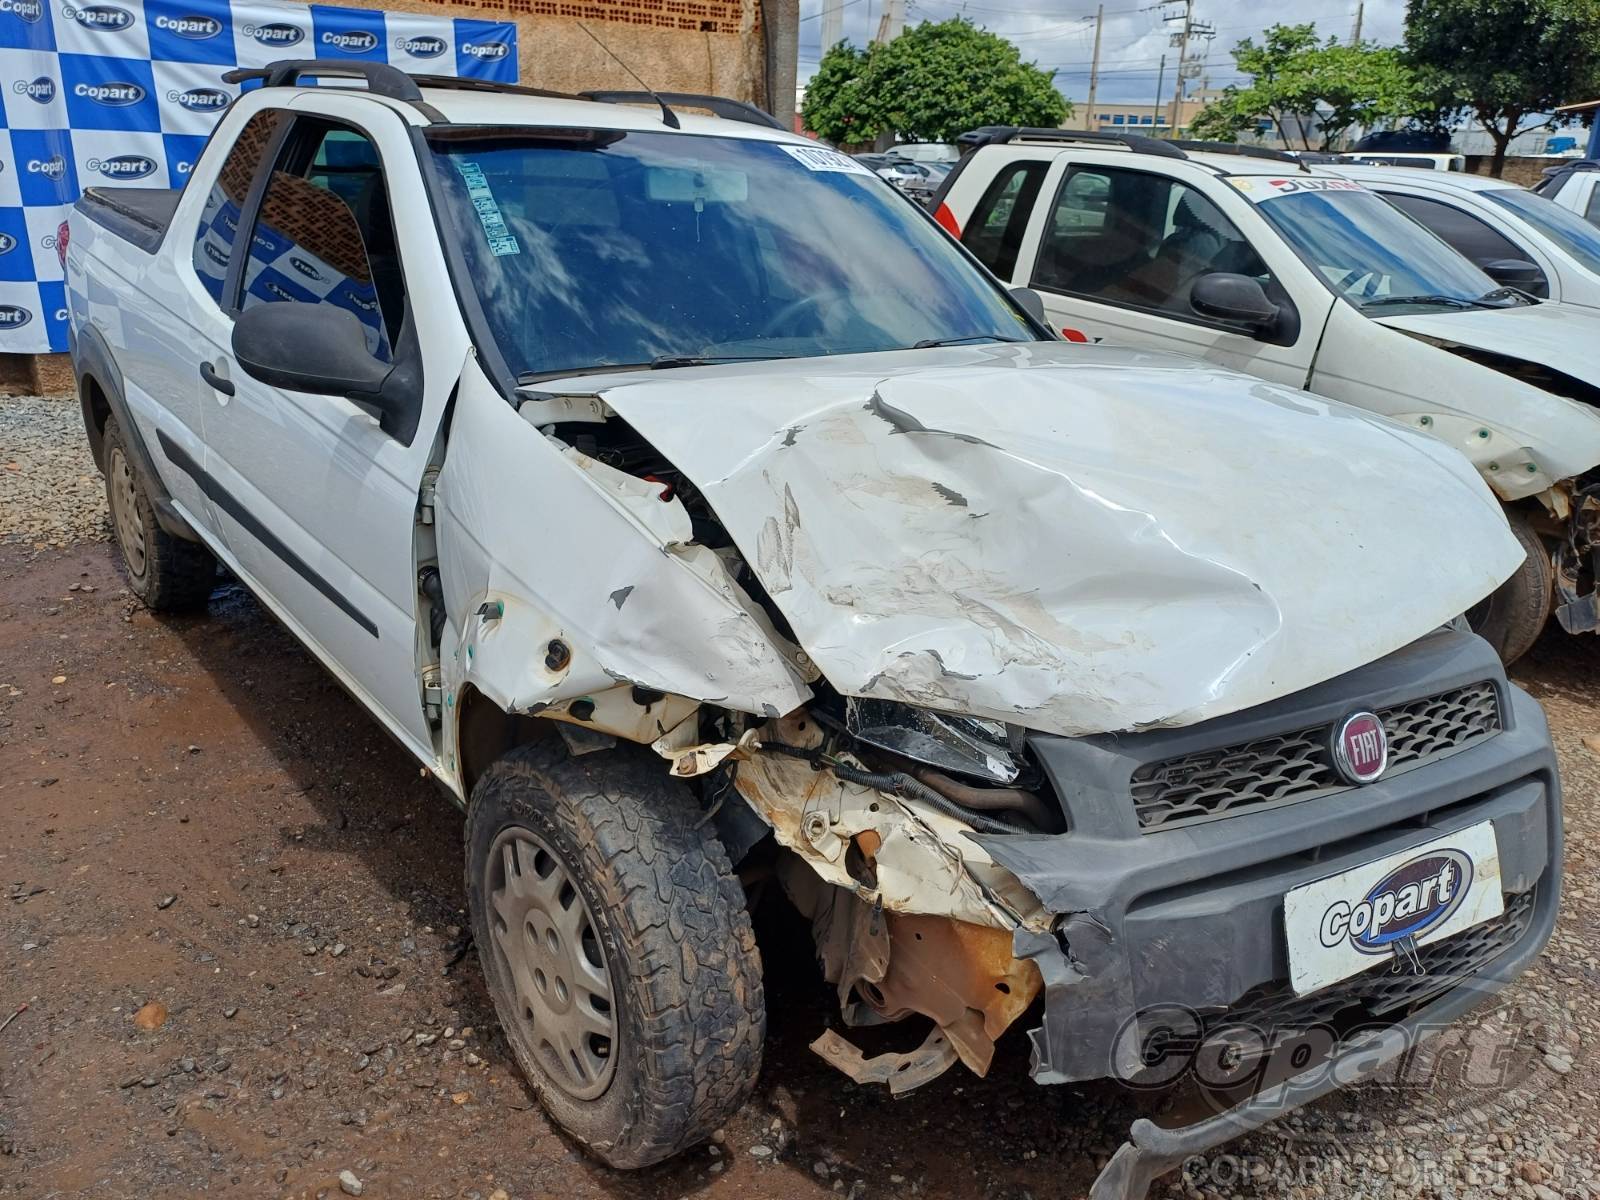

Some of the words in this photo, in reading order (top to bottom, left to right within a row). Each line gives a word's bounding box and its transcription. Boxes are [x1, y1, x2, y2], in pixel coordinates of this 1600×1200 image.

[62, 5, 126, 25] Copart
[155, 16, 215, 33] Copart
[242, 24, 297, 42] Copart
[322, 32, 372, 49] Copart
[394, 37, 440, 53] Copart
[462, 43, 504, 57] Copart
[13, 80, 52, 97] Copart
[75, 83, 137, 101] Copart
[167, 90, 226, 107] Copart
[86, 158, 149, 175] Copart
[1350, 729, 1379, 767] FIAT
[1320, 856, 1455, 948] Copart
